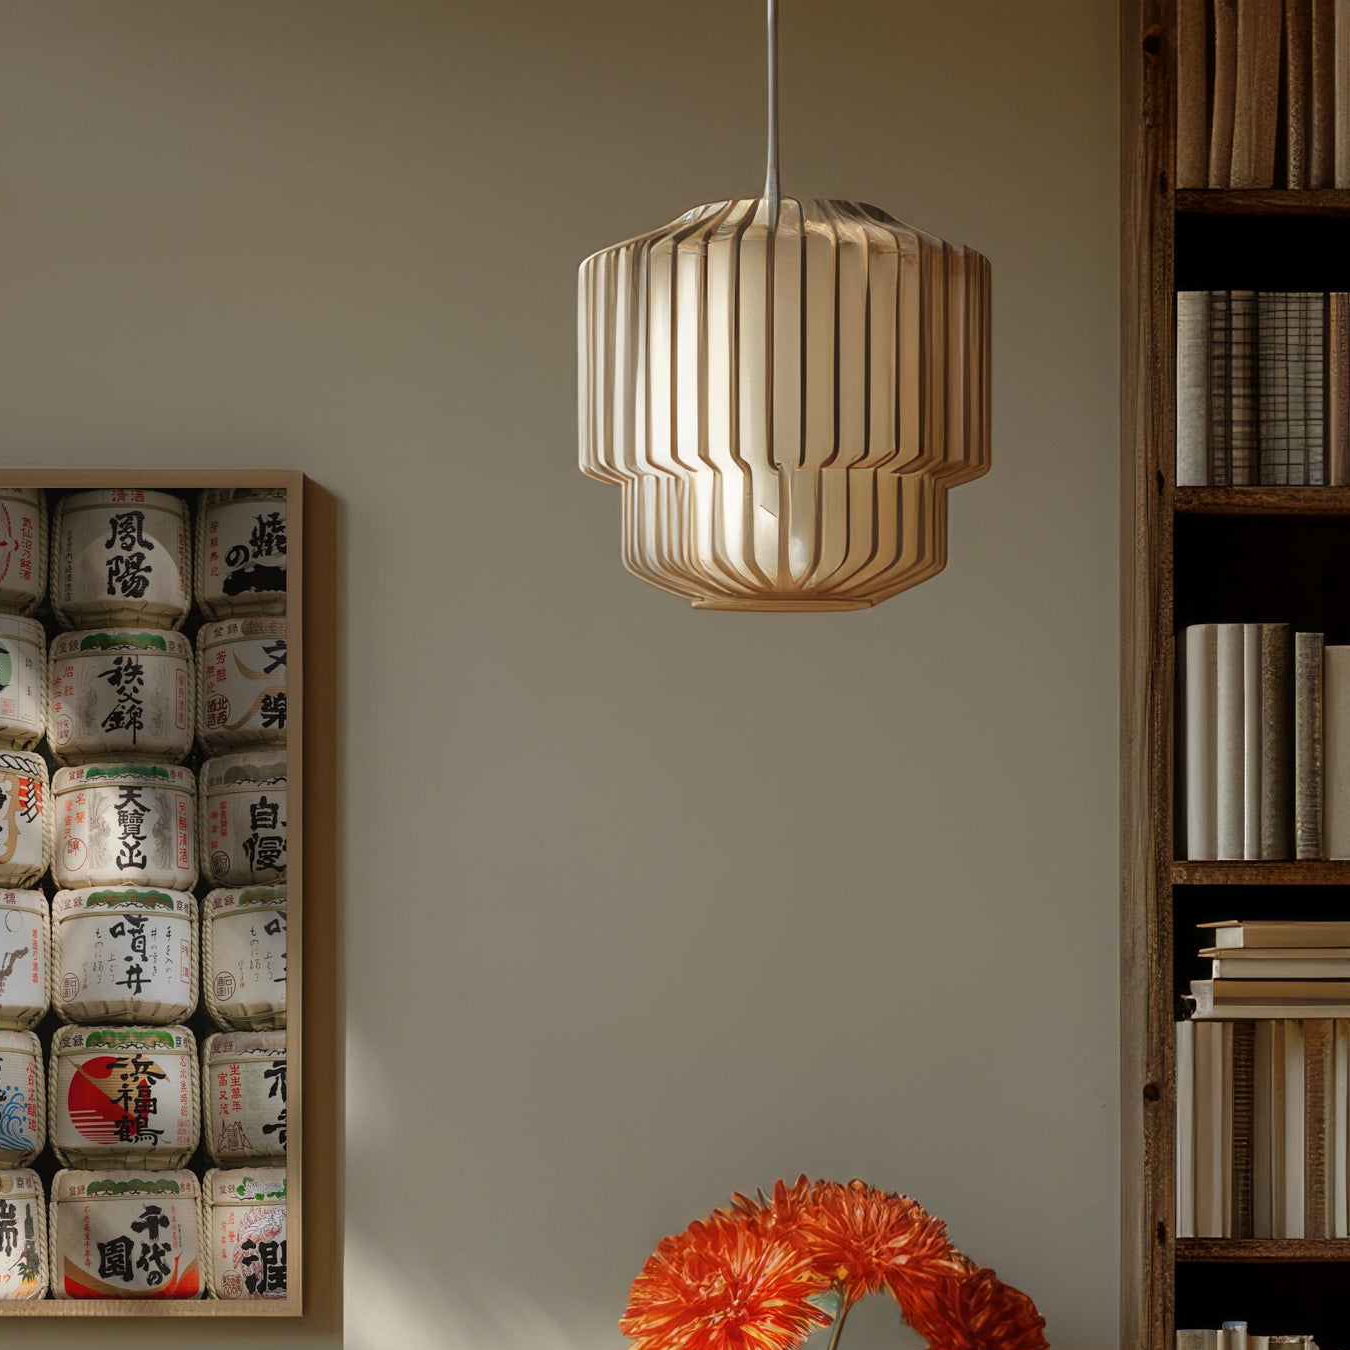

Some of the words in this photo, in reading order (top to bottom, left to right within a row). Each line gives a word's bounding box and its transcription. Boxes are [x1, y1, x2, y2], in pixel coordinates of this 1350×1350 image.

[111, 489, 145, 503] 清酒
[105, 511, 154, 598] 鳳陽
[97, 656, 144, 745] 秩父錦
